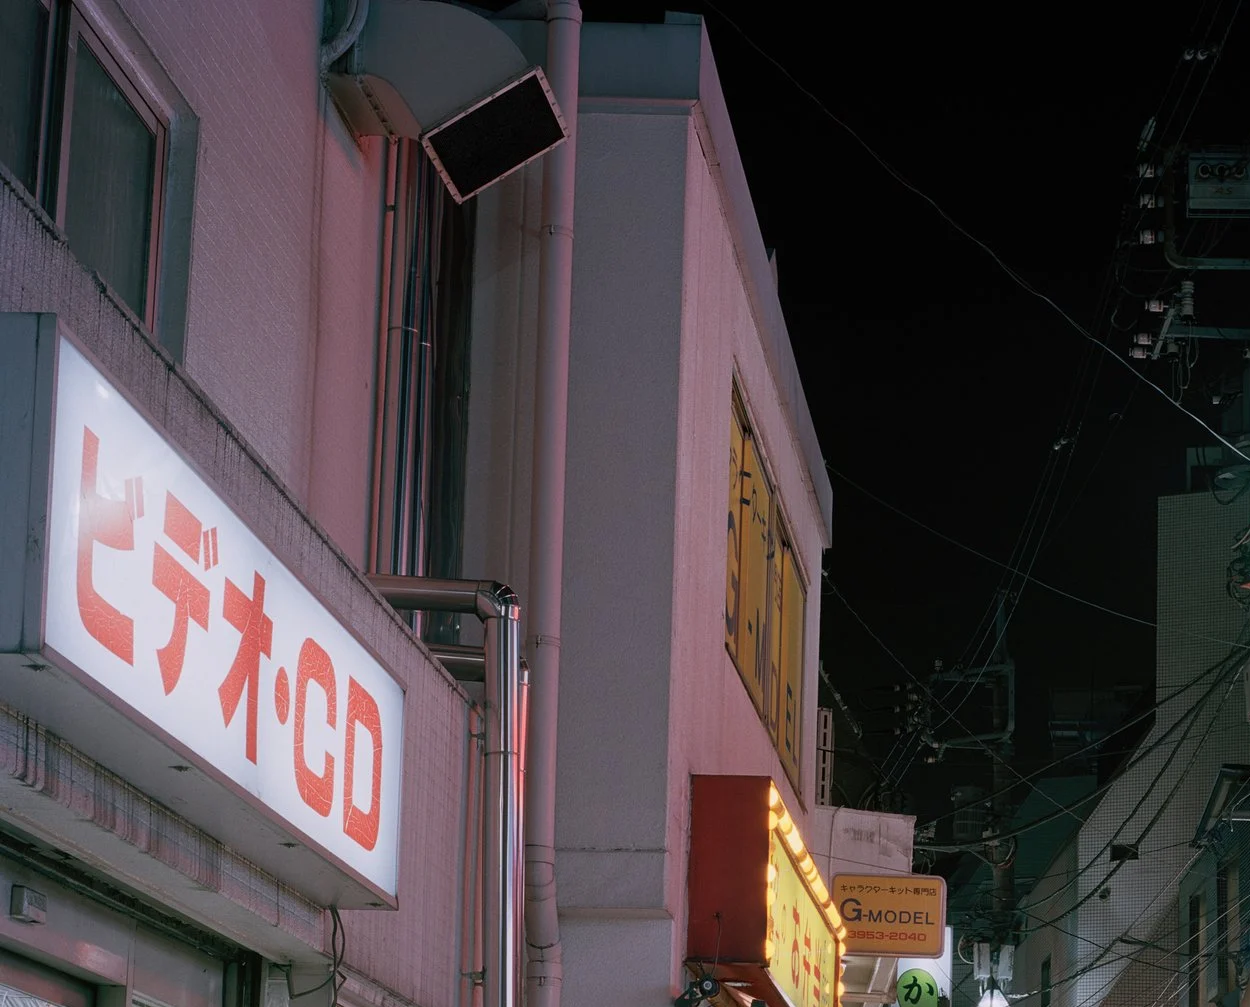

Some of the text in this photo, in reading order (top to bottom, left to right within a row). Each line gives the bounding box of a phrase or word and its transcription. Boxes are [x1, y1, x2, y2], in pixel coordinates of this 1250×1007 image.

[76, 426, 383, 852] ビデオ・CD
[840, 898, 935, 925] G-MODEL
[848, 930, 926, 942] 3953-2040
